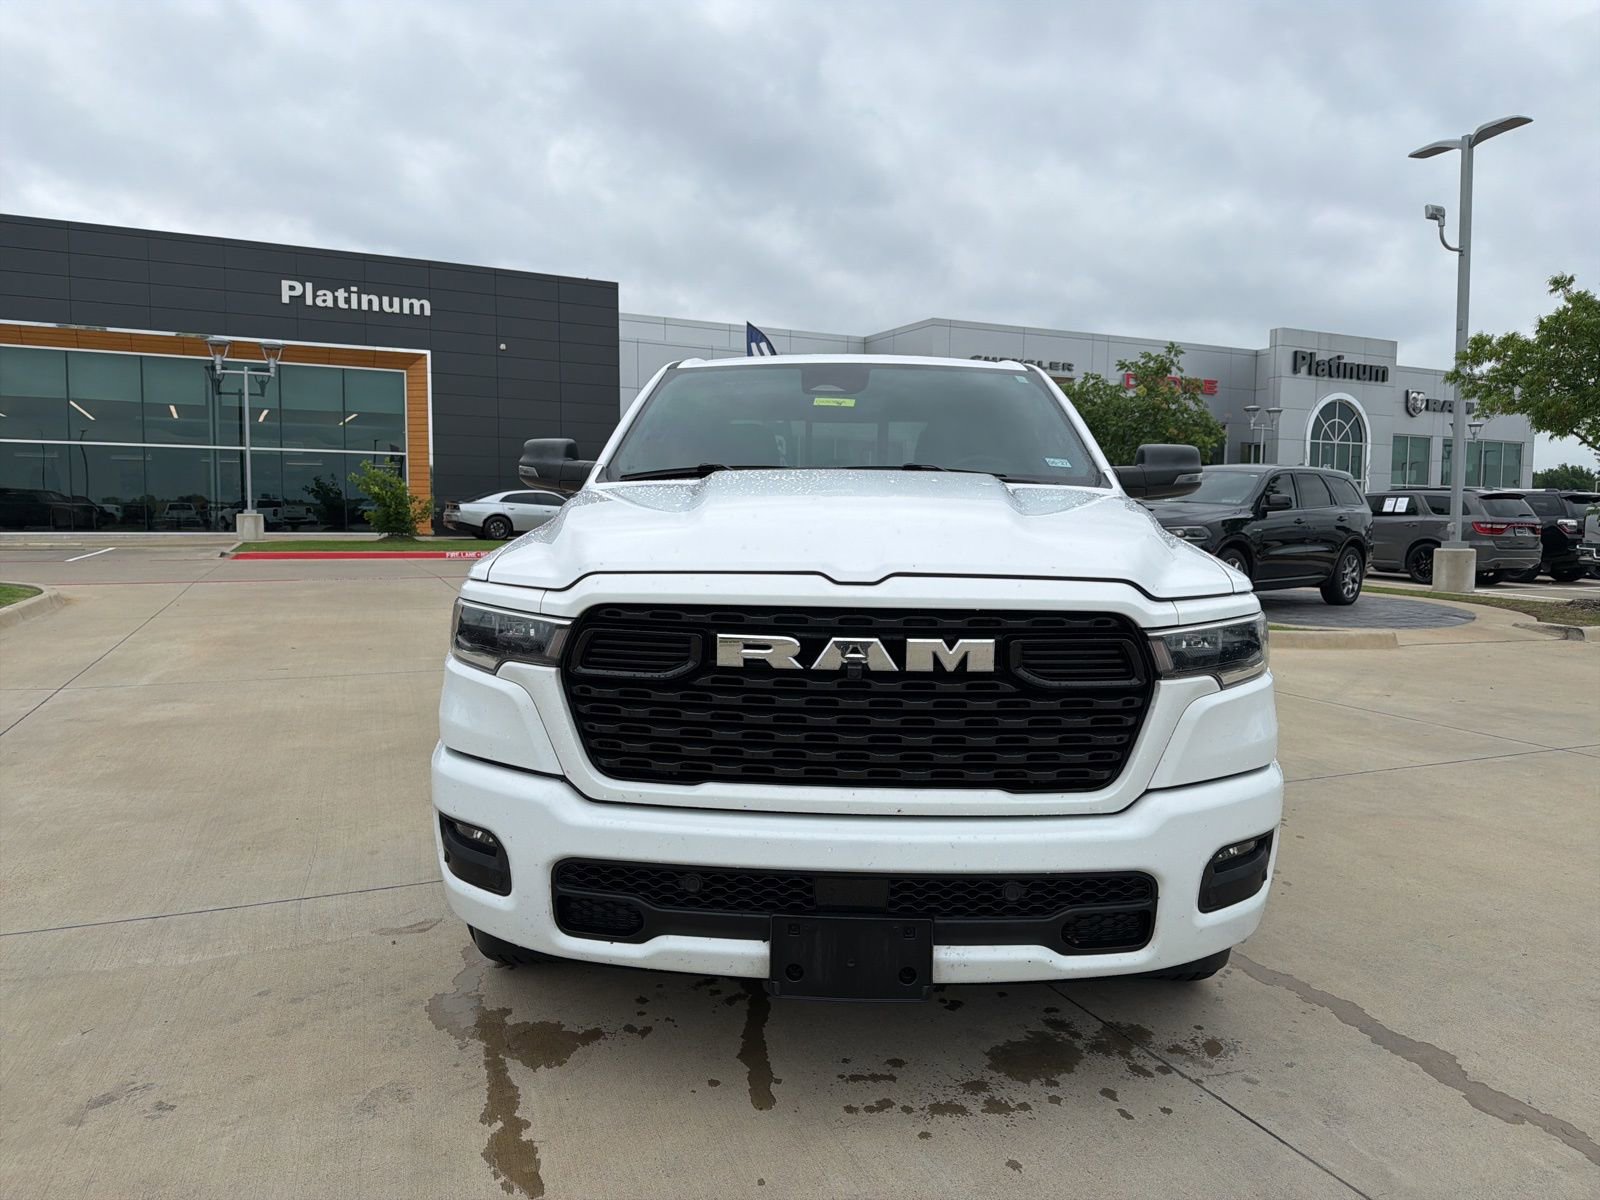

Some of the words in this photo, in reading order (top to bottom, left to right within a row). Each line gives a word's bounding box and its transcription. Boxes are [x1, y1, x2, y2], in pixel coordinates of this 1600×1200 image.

[281, 279, 431, 316] Platinum
[1292, 350, 1389, 382] Platinum
[1124, 373, 1218, 395] DDE
[717, 634, 995, 673] RAM
